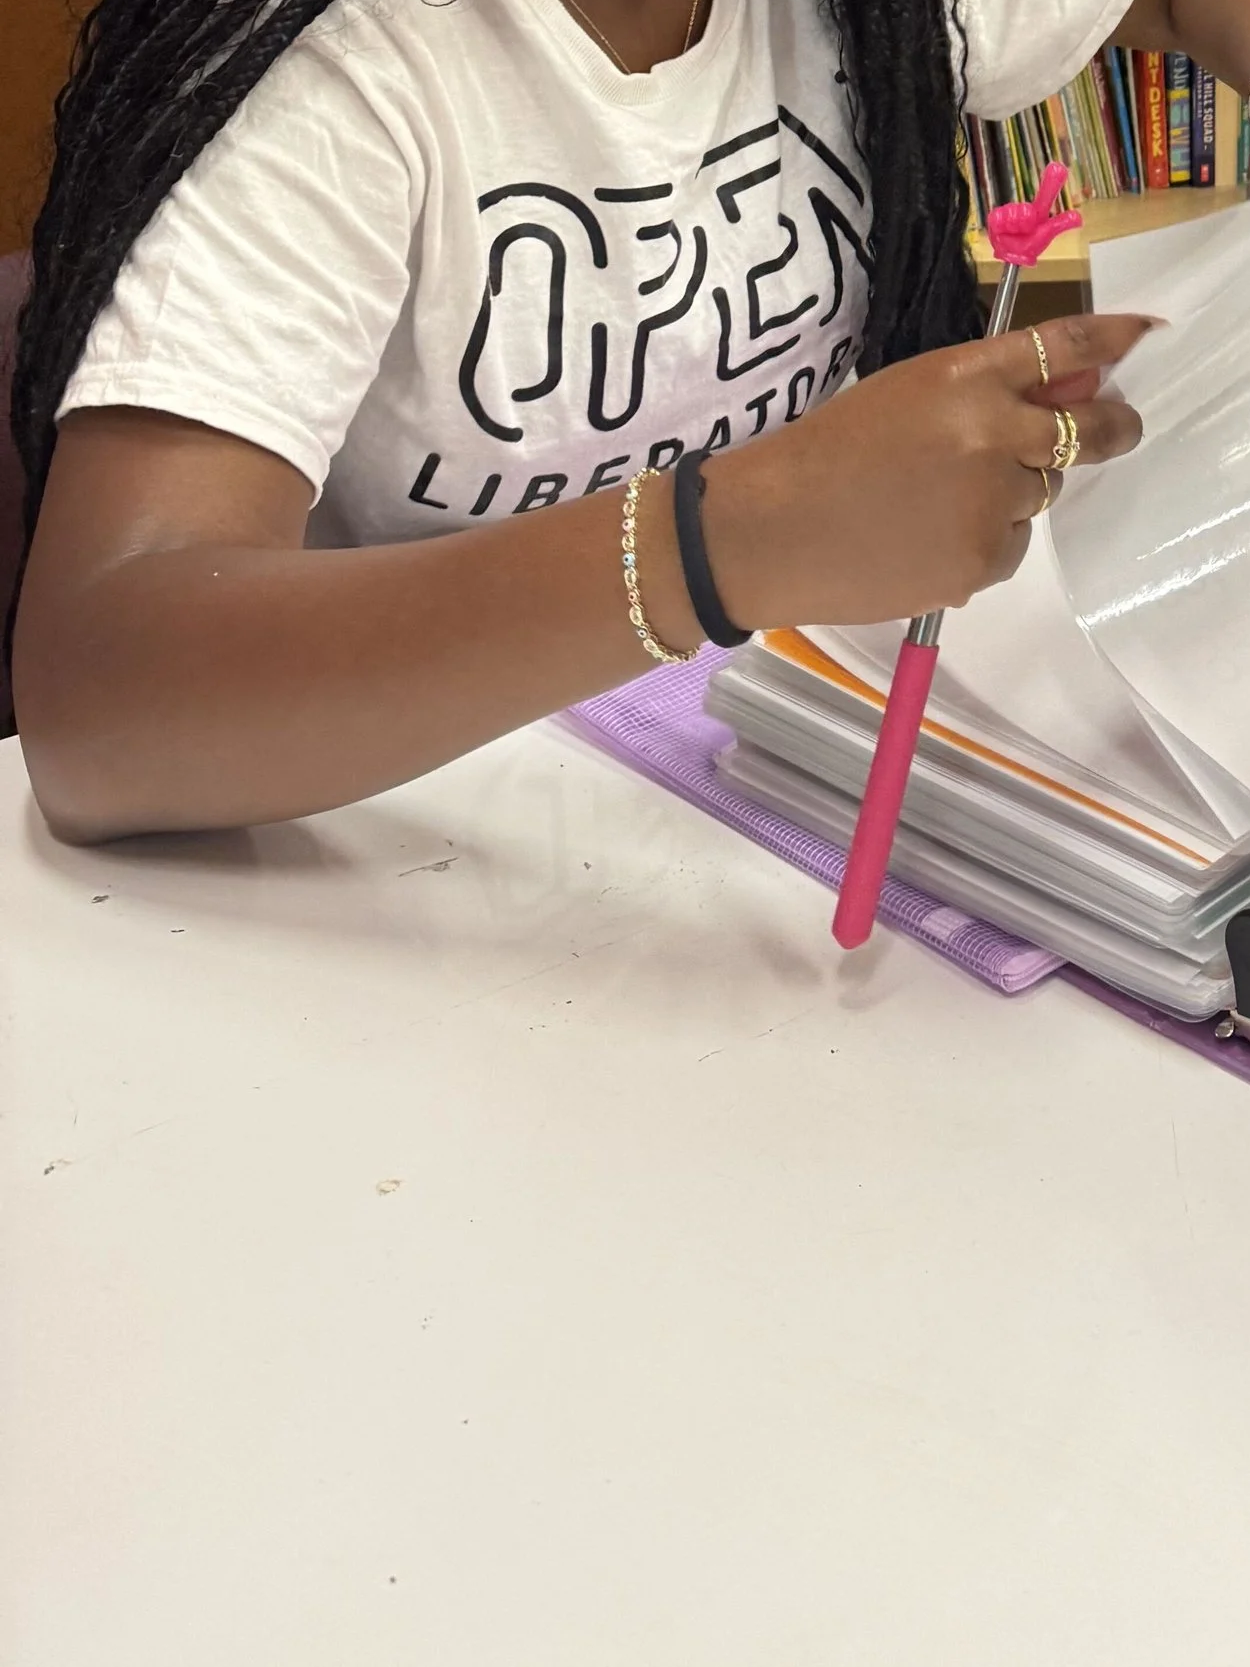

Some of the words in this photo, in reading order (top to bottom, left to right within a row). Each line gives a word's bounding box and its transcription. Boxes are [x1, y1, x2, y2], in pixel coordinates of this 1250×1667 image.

[1203, 82, 1212, 104] HILL
[1149, 86, 1163, 157] DESK
[1203, 107, 1213, 143] SQUAD
[459, 104, 875, 442] OPEN
